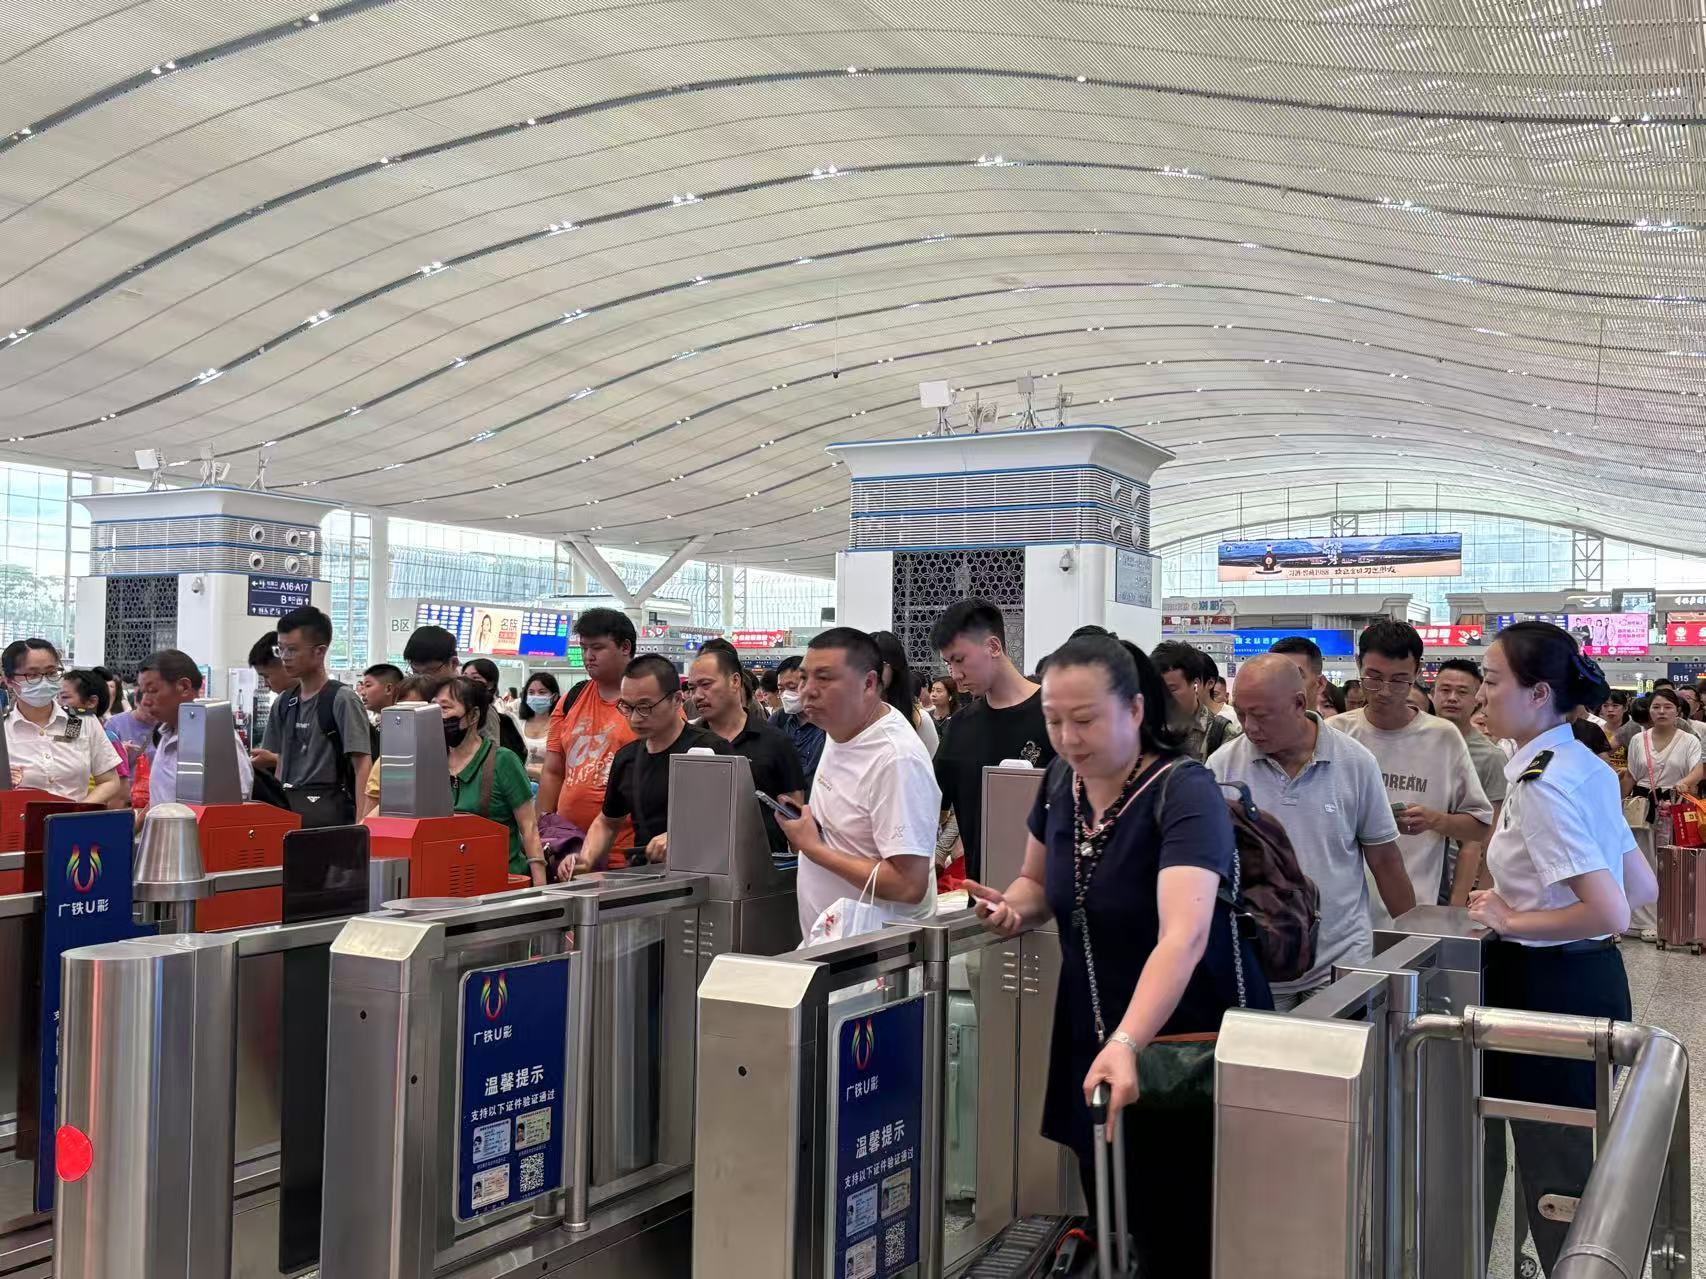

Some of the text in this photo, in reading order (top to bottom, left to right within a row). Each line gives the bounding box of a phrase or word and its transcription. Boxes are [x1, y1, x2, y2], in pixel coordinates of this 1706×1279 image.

[281, 595, 287, 604] B
[392, 619, 410, 631] B区
[1381, 772, 1428, 793] DREAM
[58, 898, 109, 917] 广铁U彩
[473, 1024, 513, 1046] 广铁U彩
[484, 1064, 544, 1097] 温馨提示
[846, 1074, 879, 1102] 广铁U彩
[470, 1088, 556, 1122] 支持以下证件验证通过
[855, 1119, 905, 1159] 温馨提示
[844, 1145, 914, 1190] 支持以下证件验证通过
